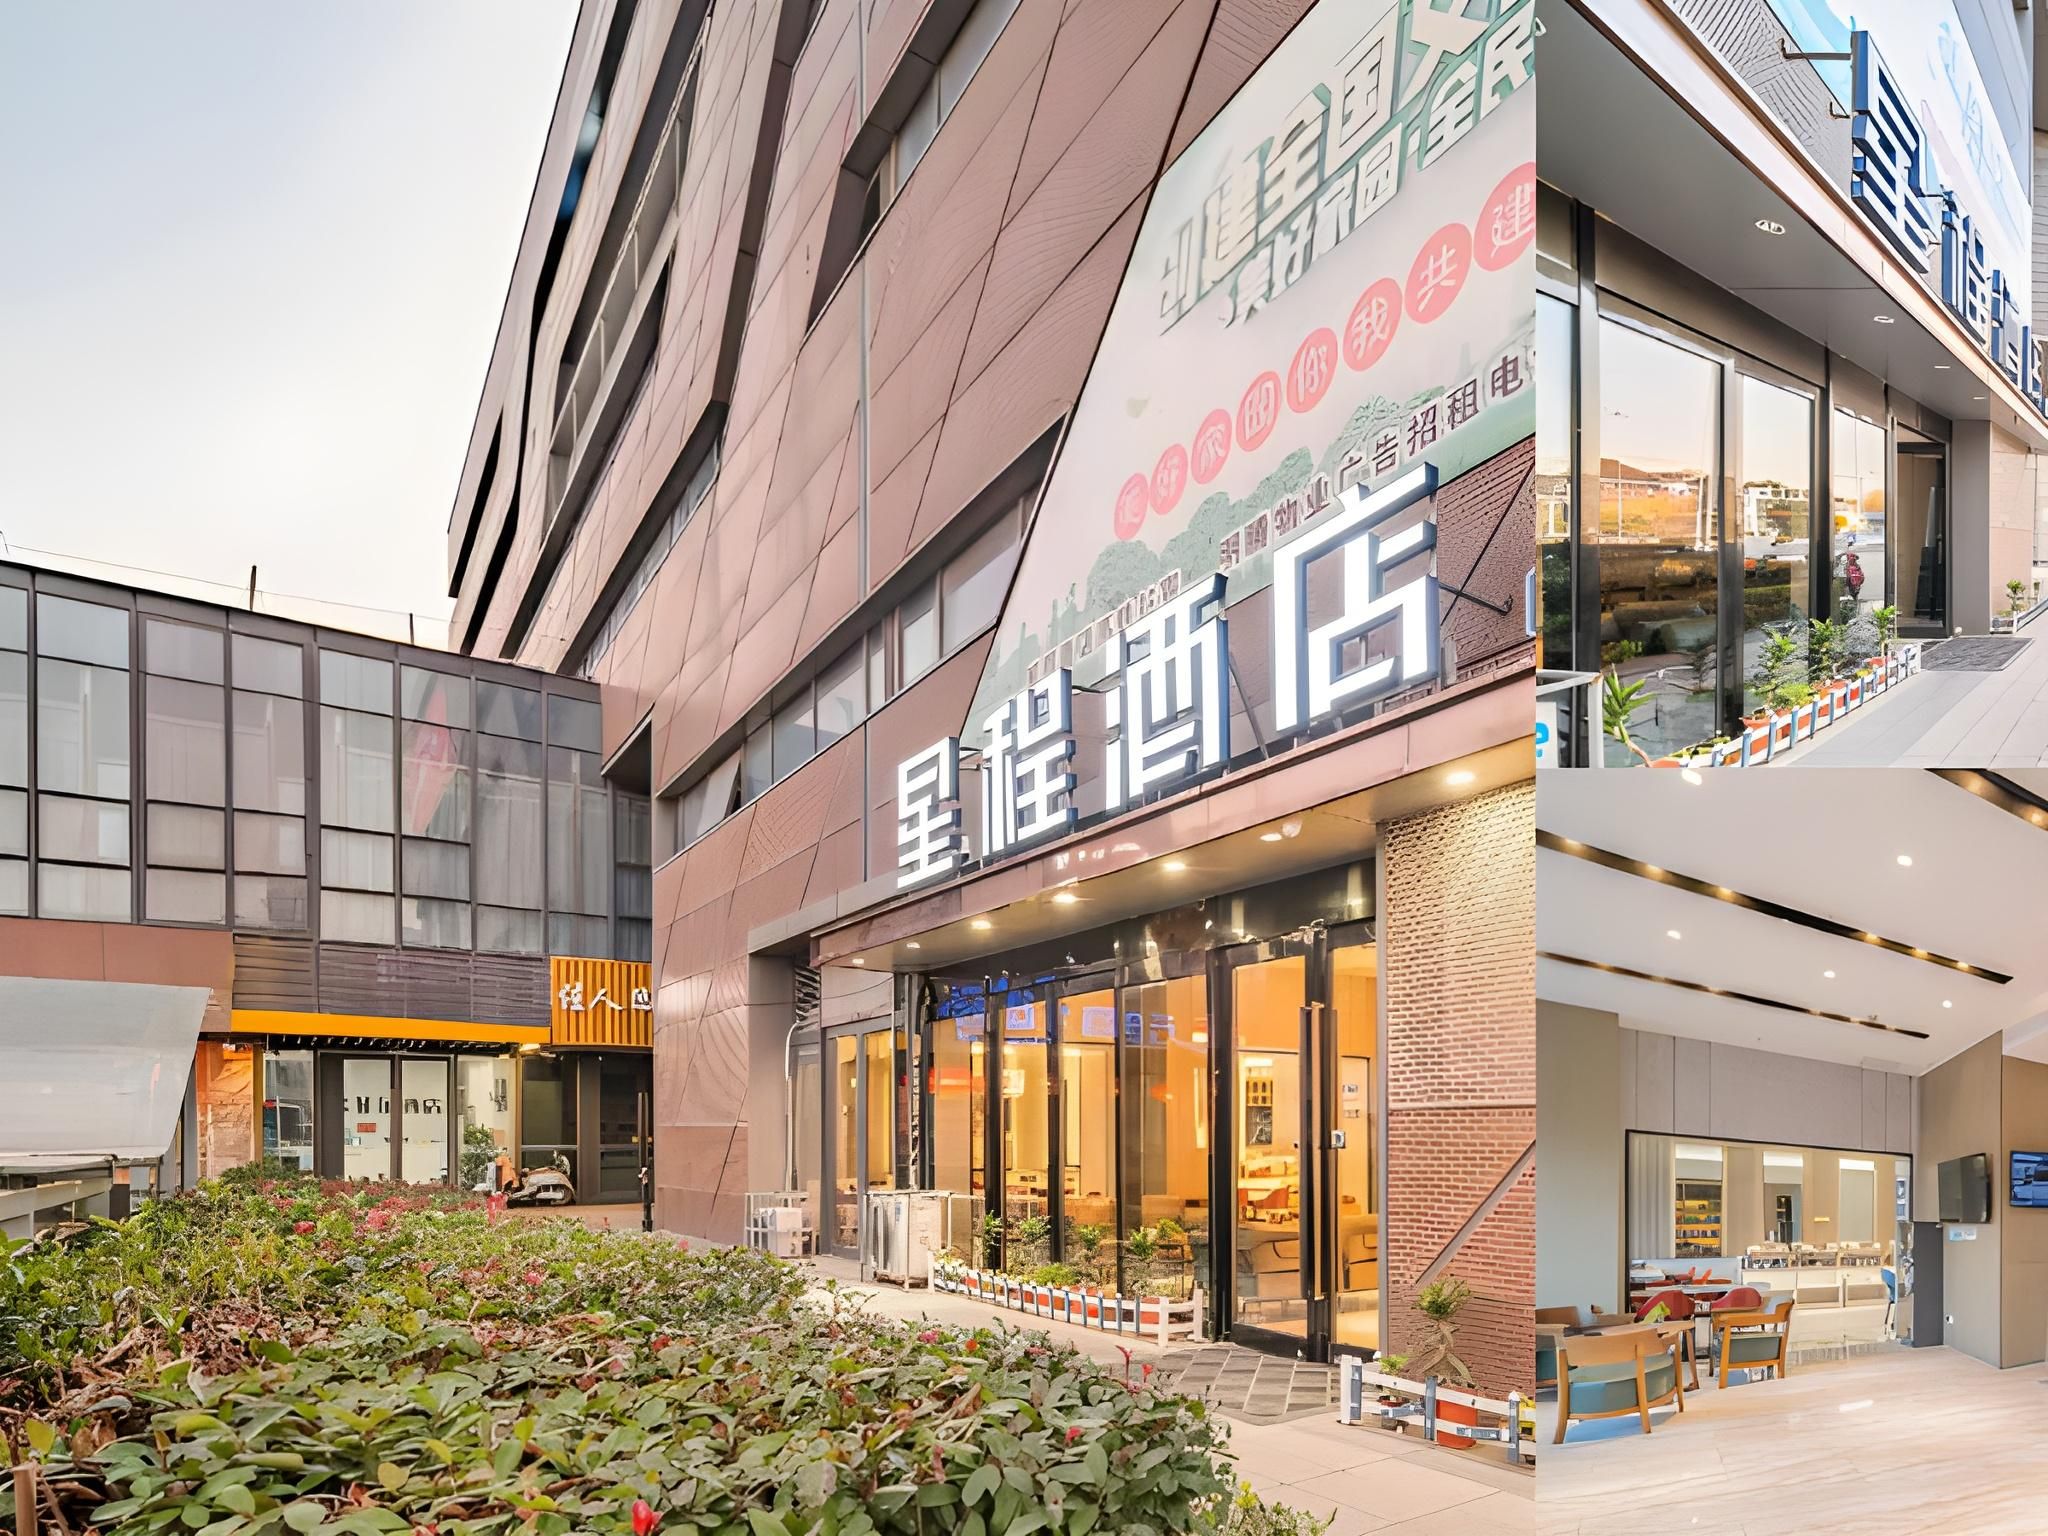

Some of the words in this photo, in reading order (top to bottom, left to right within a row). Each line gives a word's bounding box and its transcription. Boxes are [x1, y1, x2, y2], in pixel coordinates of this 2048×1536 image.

[1160, 0, 1526, 336] 创建全国文
[1220, 348, 1536, 569] 物业广告招租电
[897, 461, 1439, 890] 星程酒店
